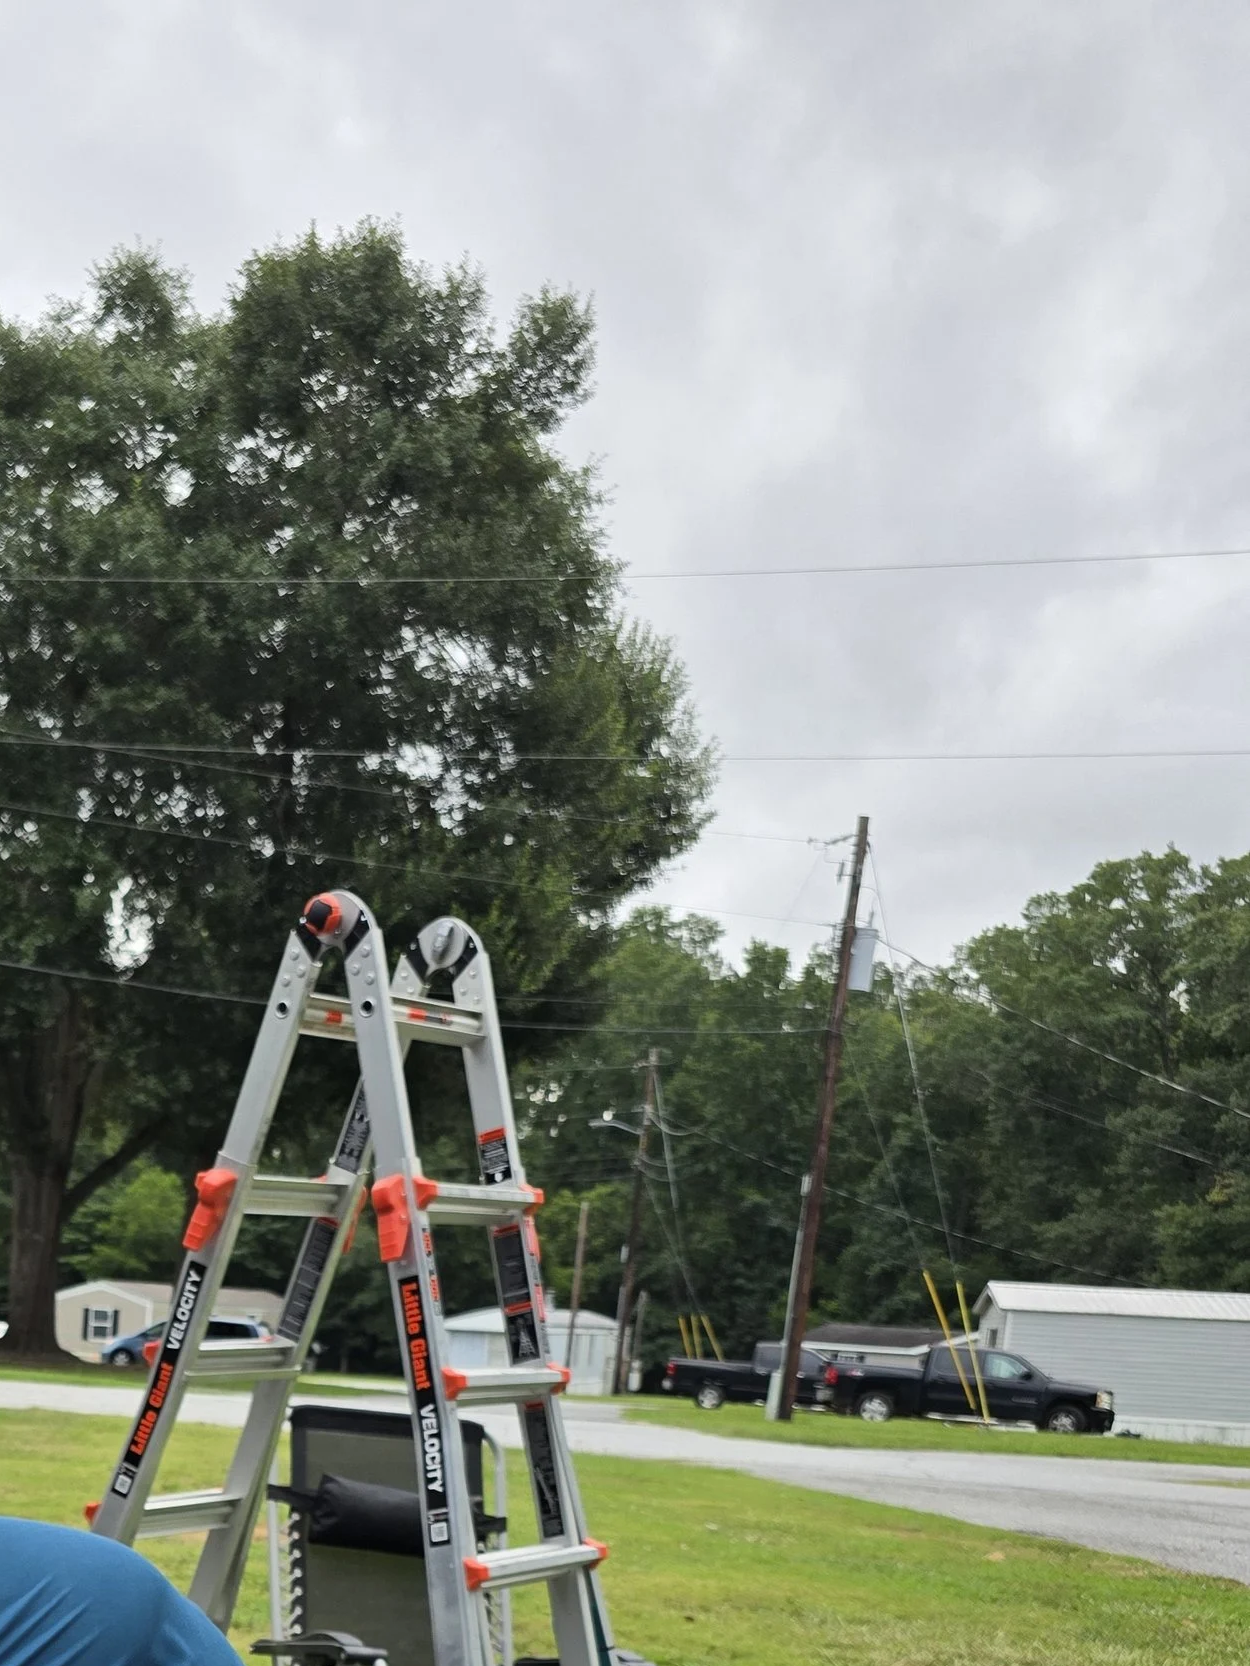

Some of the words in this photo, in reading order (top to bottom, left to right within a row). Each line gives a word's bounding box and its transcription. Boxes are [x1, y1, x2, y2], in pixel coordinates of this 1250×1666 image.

[401, 1281, 421, 1335] Little
[130, 1411, 157, 1455] Little
[148, 1362, 174, 1409] Giant
[166, 1270, 202, 1351] VELOCITY
[409, 1338, 432, 1390] Giant
[419, 1403, 444, 1494] VELOCITY
